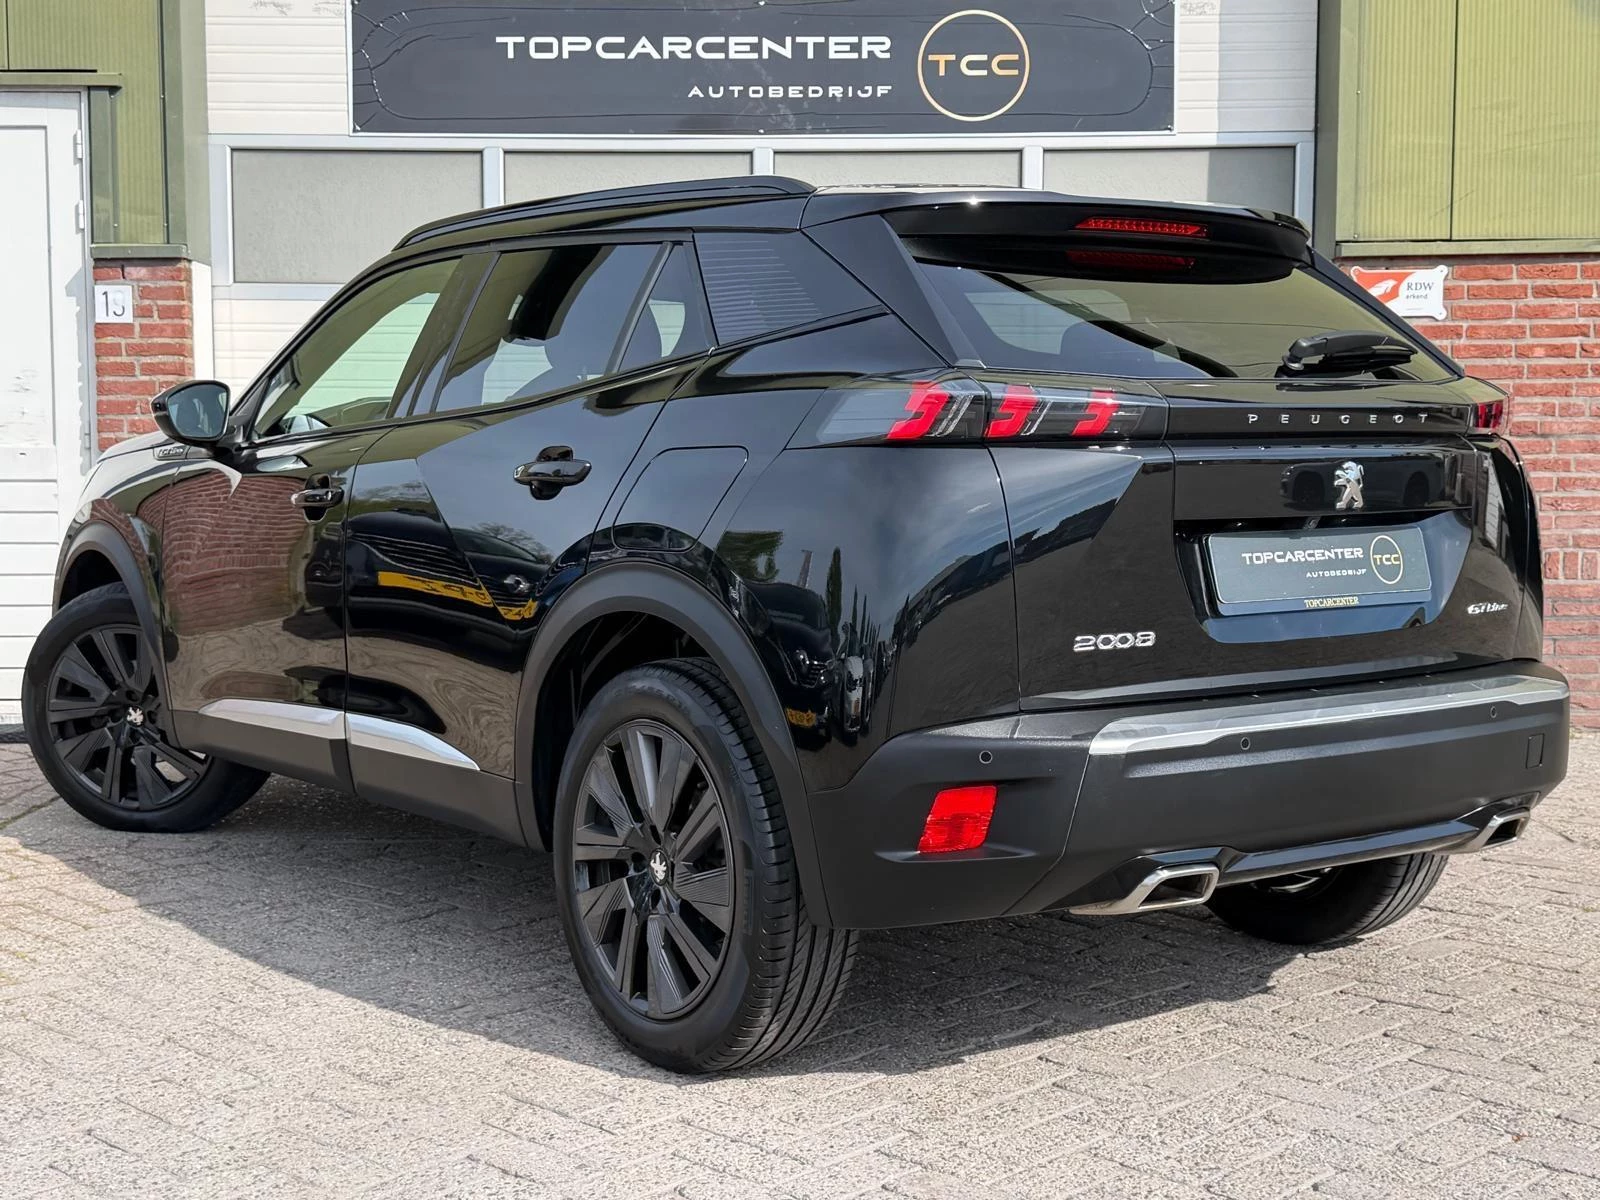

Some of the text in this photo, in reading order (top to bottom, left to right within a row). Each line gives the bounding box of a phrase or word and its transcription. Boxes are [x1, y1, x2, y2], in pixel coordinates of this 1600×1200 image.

[495, 35, 892, 60] TOPCARCENTER
[927, 53, 1020, 77] TCC
[687, 85, 893, 99] AUTOBEDRIJF
[1406, 282, 1434, 291] RDW
[1247, 412, 1429, 425] PEUGEOT
[1241, 547, 1364, 565] TOPCARCENTER
[1373, 553, 1400, 566] TCC
[1303, 596, 1360, 609] TOPCARCENTER
[1072, 631, 1156, 653] 2008
